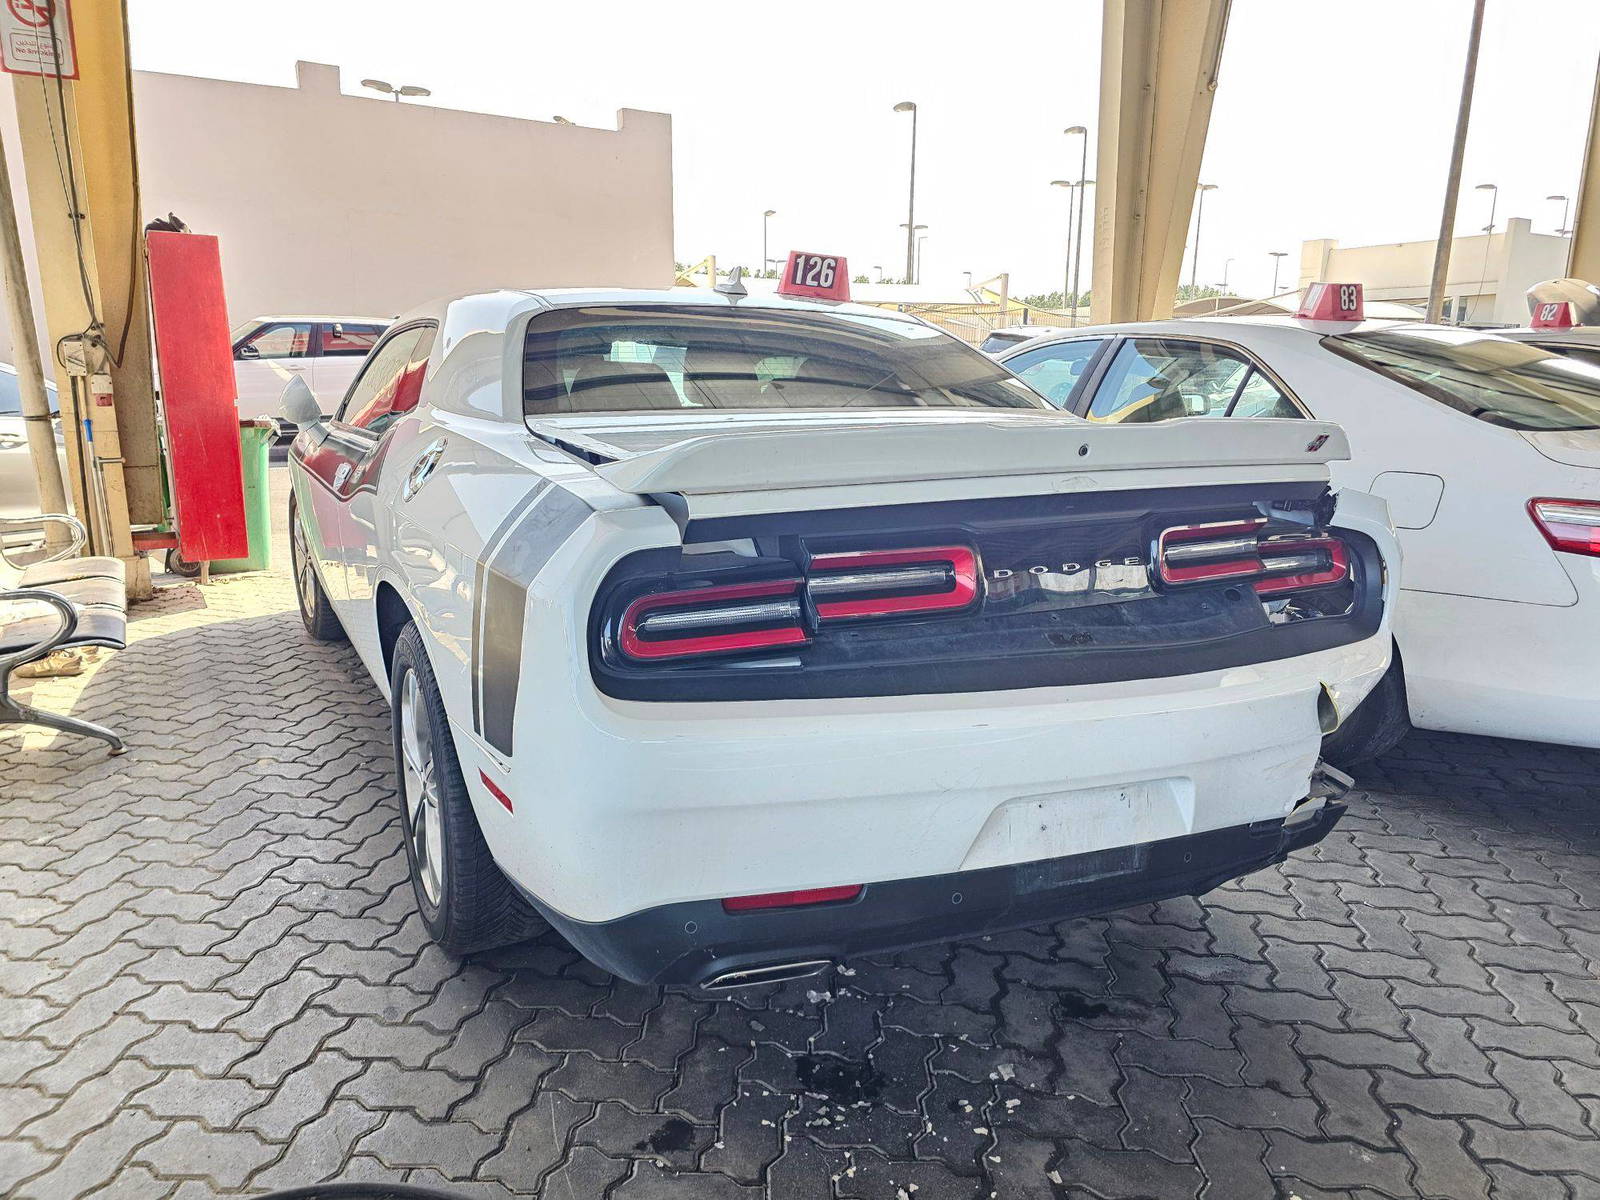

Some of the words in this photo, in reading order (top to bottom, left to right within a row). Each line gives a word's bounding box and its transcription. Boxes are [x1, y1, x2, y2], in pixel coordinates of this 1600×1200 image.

[796, 255, 836, 287] 126
[1341, 286, 1356, 310] 83
[1540, 304, 1557, 320] 82
[993, 556, 1141, 579] DODGE
